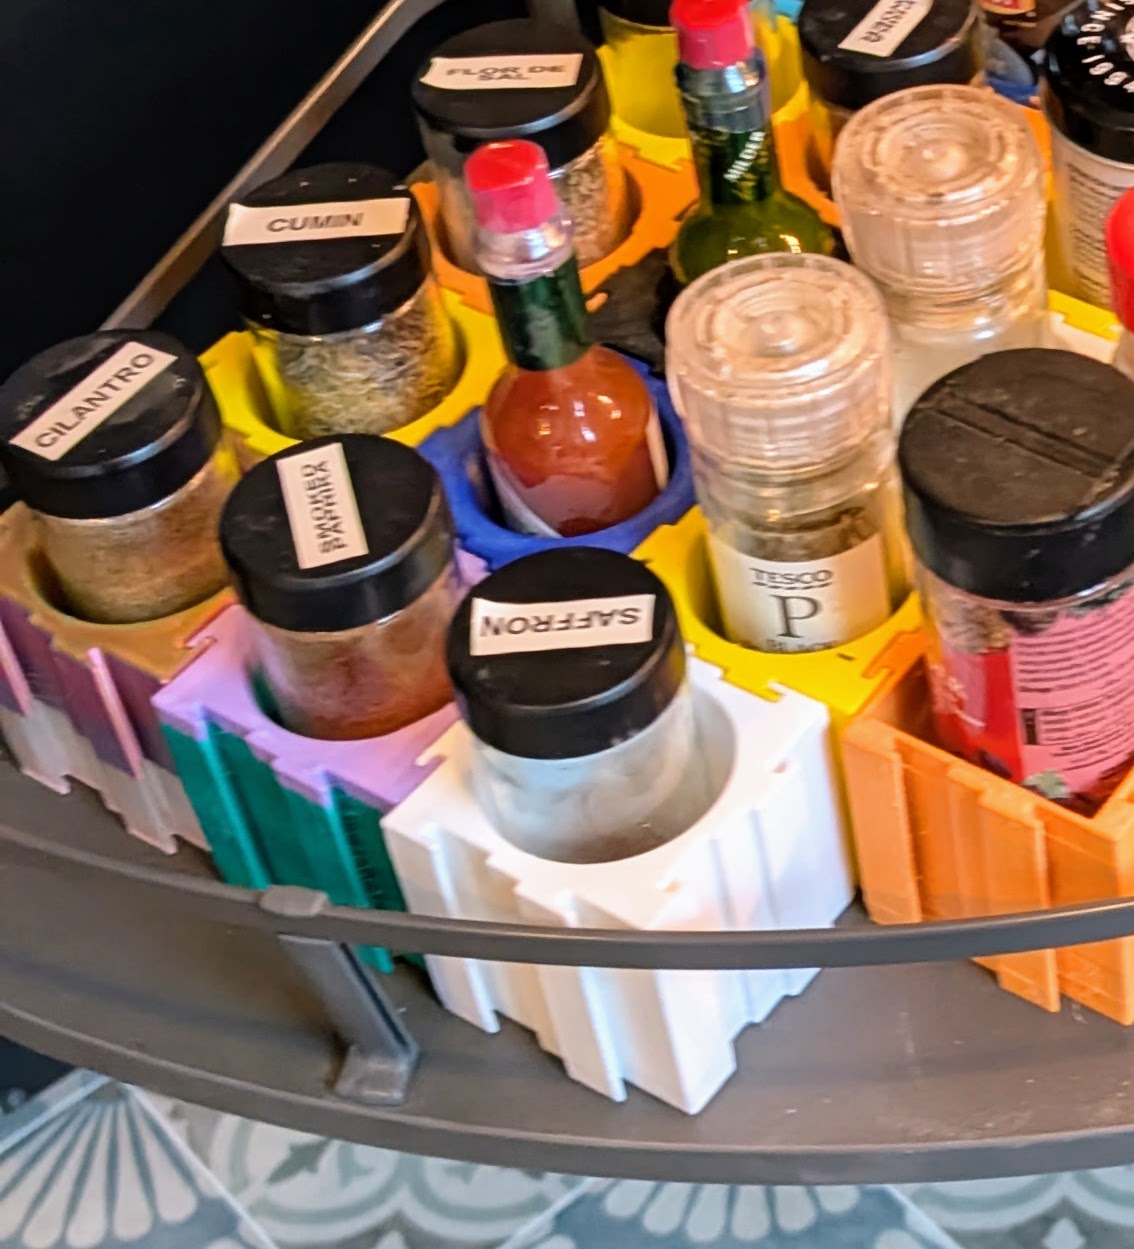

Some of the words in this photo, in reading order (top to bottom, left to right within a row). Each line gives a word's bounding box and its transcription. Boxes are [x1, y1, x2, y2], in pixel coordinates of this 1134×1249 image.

[447, 66, 522, 76] FLOR
[528, 65, 567, 74] DE
[478, 73, 530, 81] SAL
[266, 213, 365, 233] CUMIN
[35, 353, 154, 448] CILANTRO
[301, 463, 334, 553] SMOKED
[313, 460, 350, 550] PAPRIKA
[749, 567, 834, 584] TESCO
[479, 607, 642, 637] SAFFRON
[770, 595, 823, 638] P
